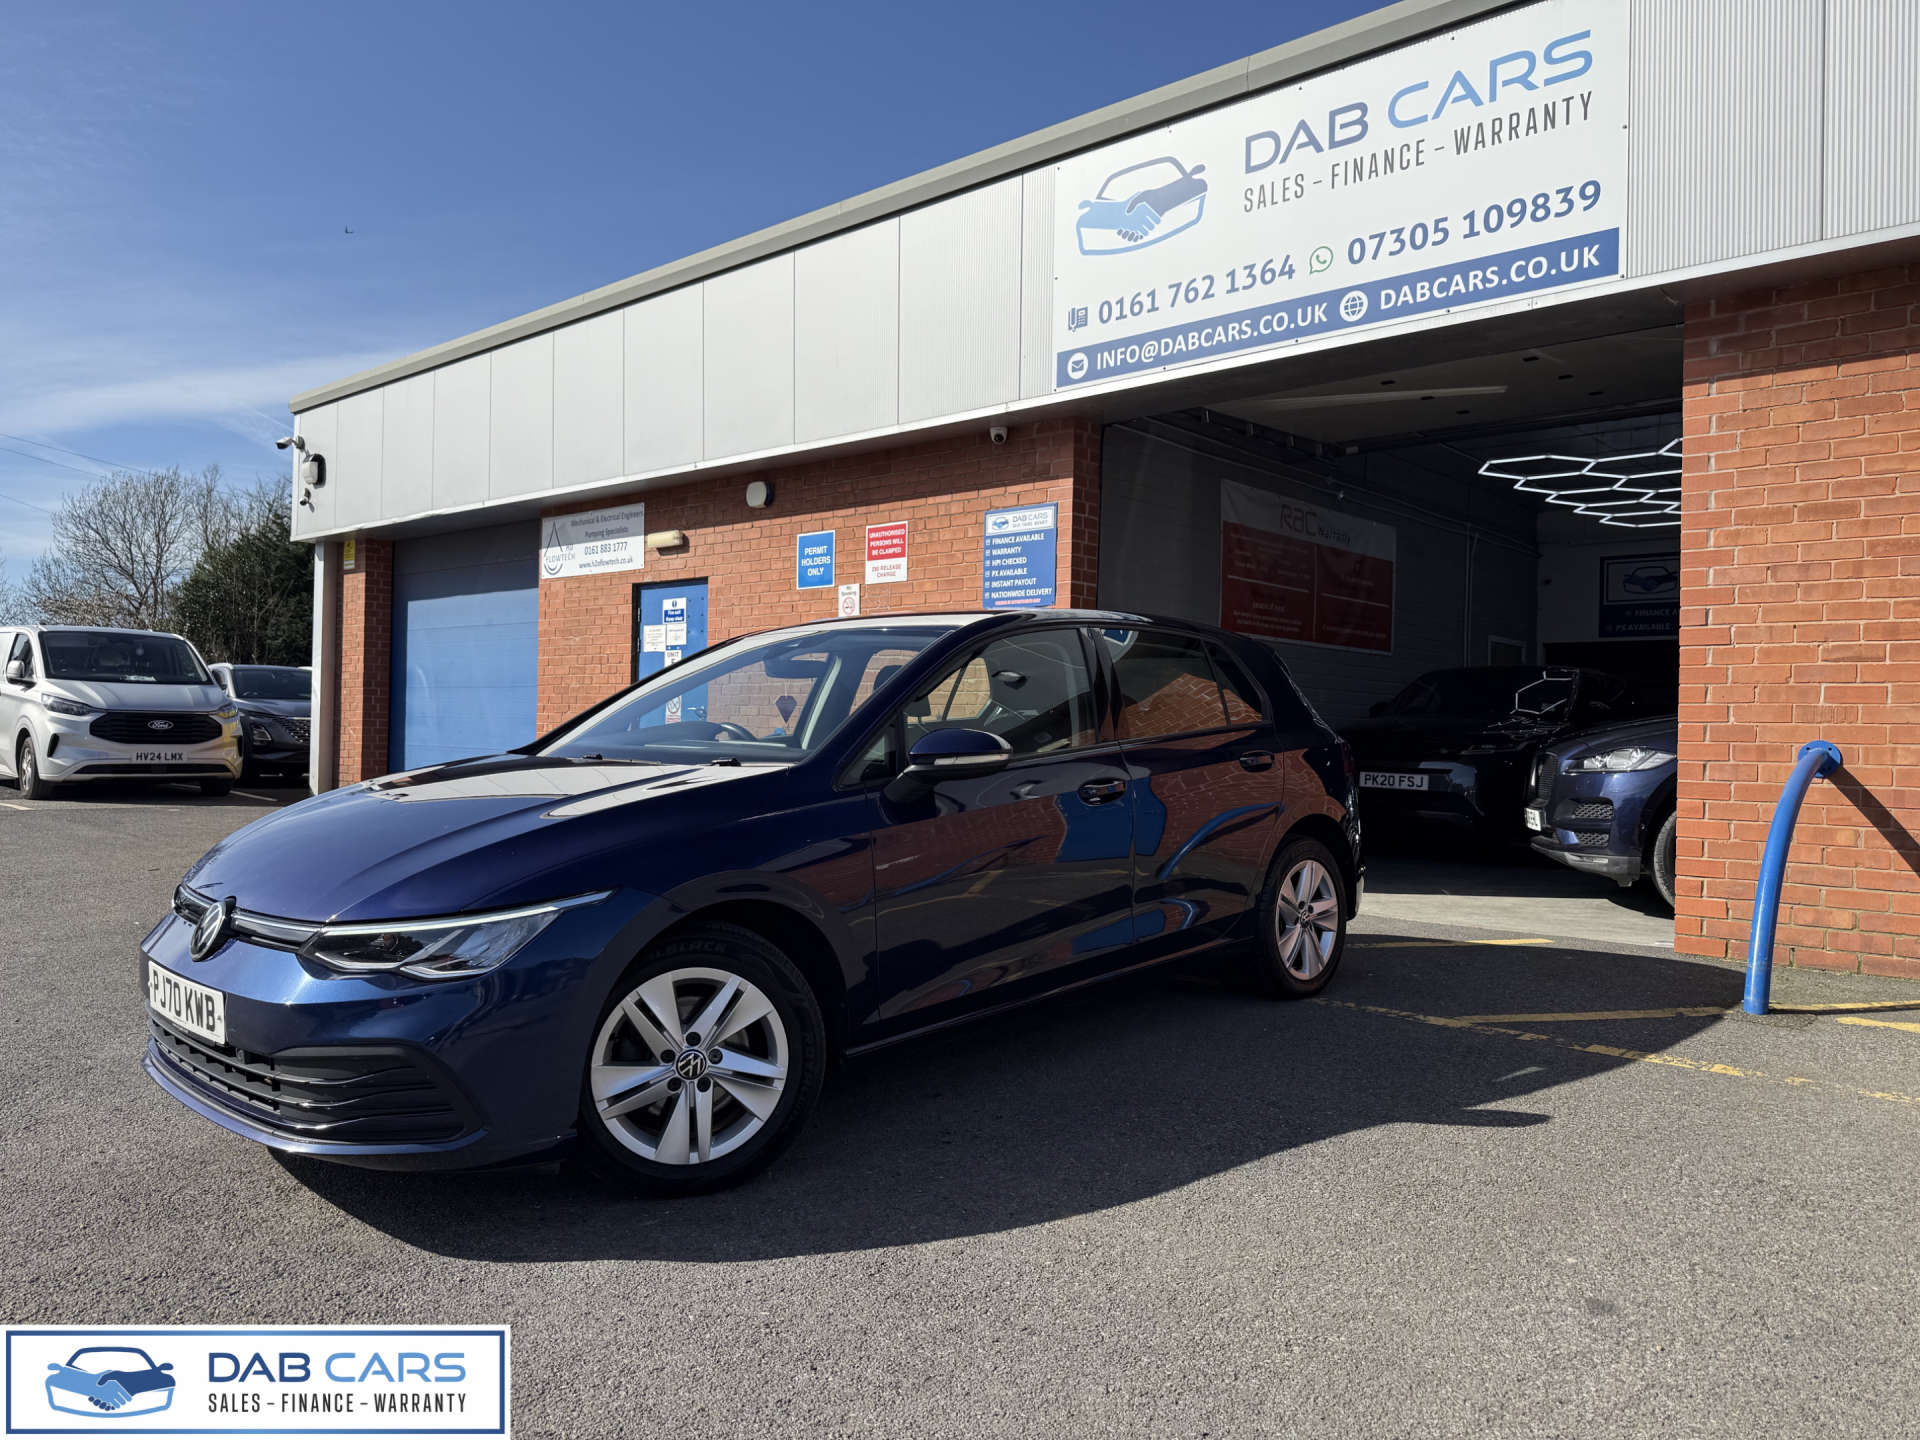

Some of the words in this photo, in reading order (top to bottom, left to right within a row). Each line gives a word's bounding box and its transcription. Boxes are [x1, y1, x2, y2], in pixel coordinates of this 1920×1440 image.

[1245, 102, 1368, 174] DAB
[1388, 30, 1593, 128] CARS
[1244, 173, 1304, 213] SALES
[1331, 139, 1426, 189] FINANCE
[1454, 91, 1593, 156] WARRANTY
[1098, 288, 1160, 324] 0161
[1169, 275, 1215, 308] 762
[1225, 254, 1296, 294] 1364
[1347, 216, 1449, 265] 07305
[1462, 180, 1601, 239] 109839
[1096, 302, 1327, 371] INFO@DABCARS.CO.UK
[1380, 244, 1600, 310] DABCARS.CO.UK
[1028, 512, 1048, 520] CARS
[992, 536, 1015, 545] FINANCE
[1016, 533, 1045, 542] AVAILABLE
[584, 545, 599, 556] 0161
[613, 541, 628, 552] 1777
[804, 545, 828, 555] PERMIT
[879, 547, 902, 555] CLAMPED
[992, 546, 1022, 555] WARRANTY
[545, 551, 576, 564] FLOWTECH
[801, 556, 831, 566] HOLDERS
[1002, 557, 1028, 566] CHECKED
[807, 567, 824, 576] ONLY
[999, 568, 1028, 577] AVAILABLE
[991, 580, 1014, 588] INSTANT
[1015, 578, 1036, 586] PAYOUT
[991, 590, 1025, 599] NATIONWIDE
[1026, 588, 1052, 597] DELIVERY
[136, 752, 162, 762] HV24
[1363, 774, 1396, 787] PK20
[1399, 774, 1424, 788] FSJ
[153, 970, 181, 1017] PJ70
[185, 986, 215, 1032] KWB
